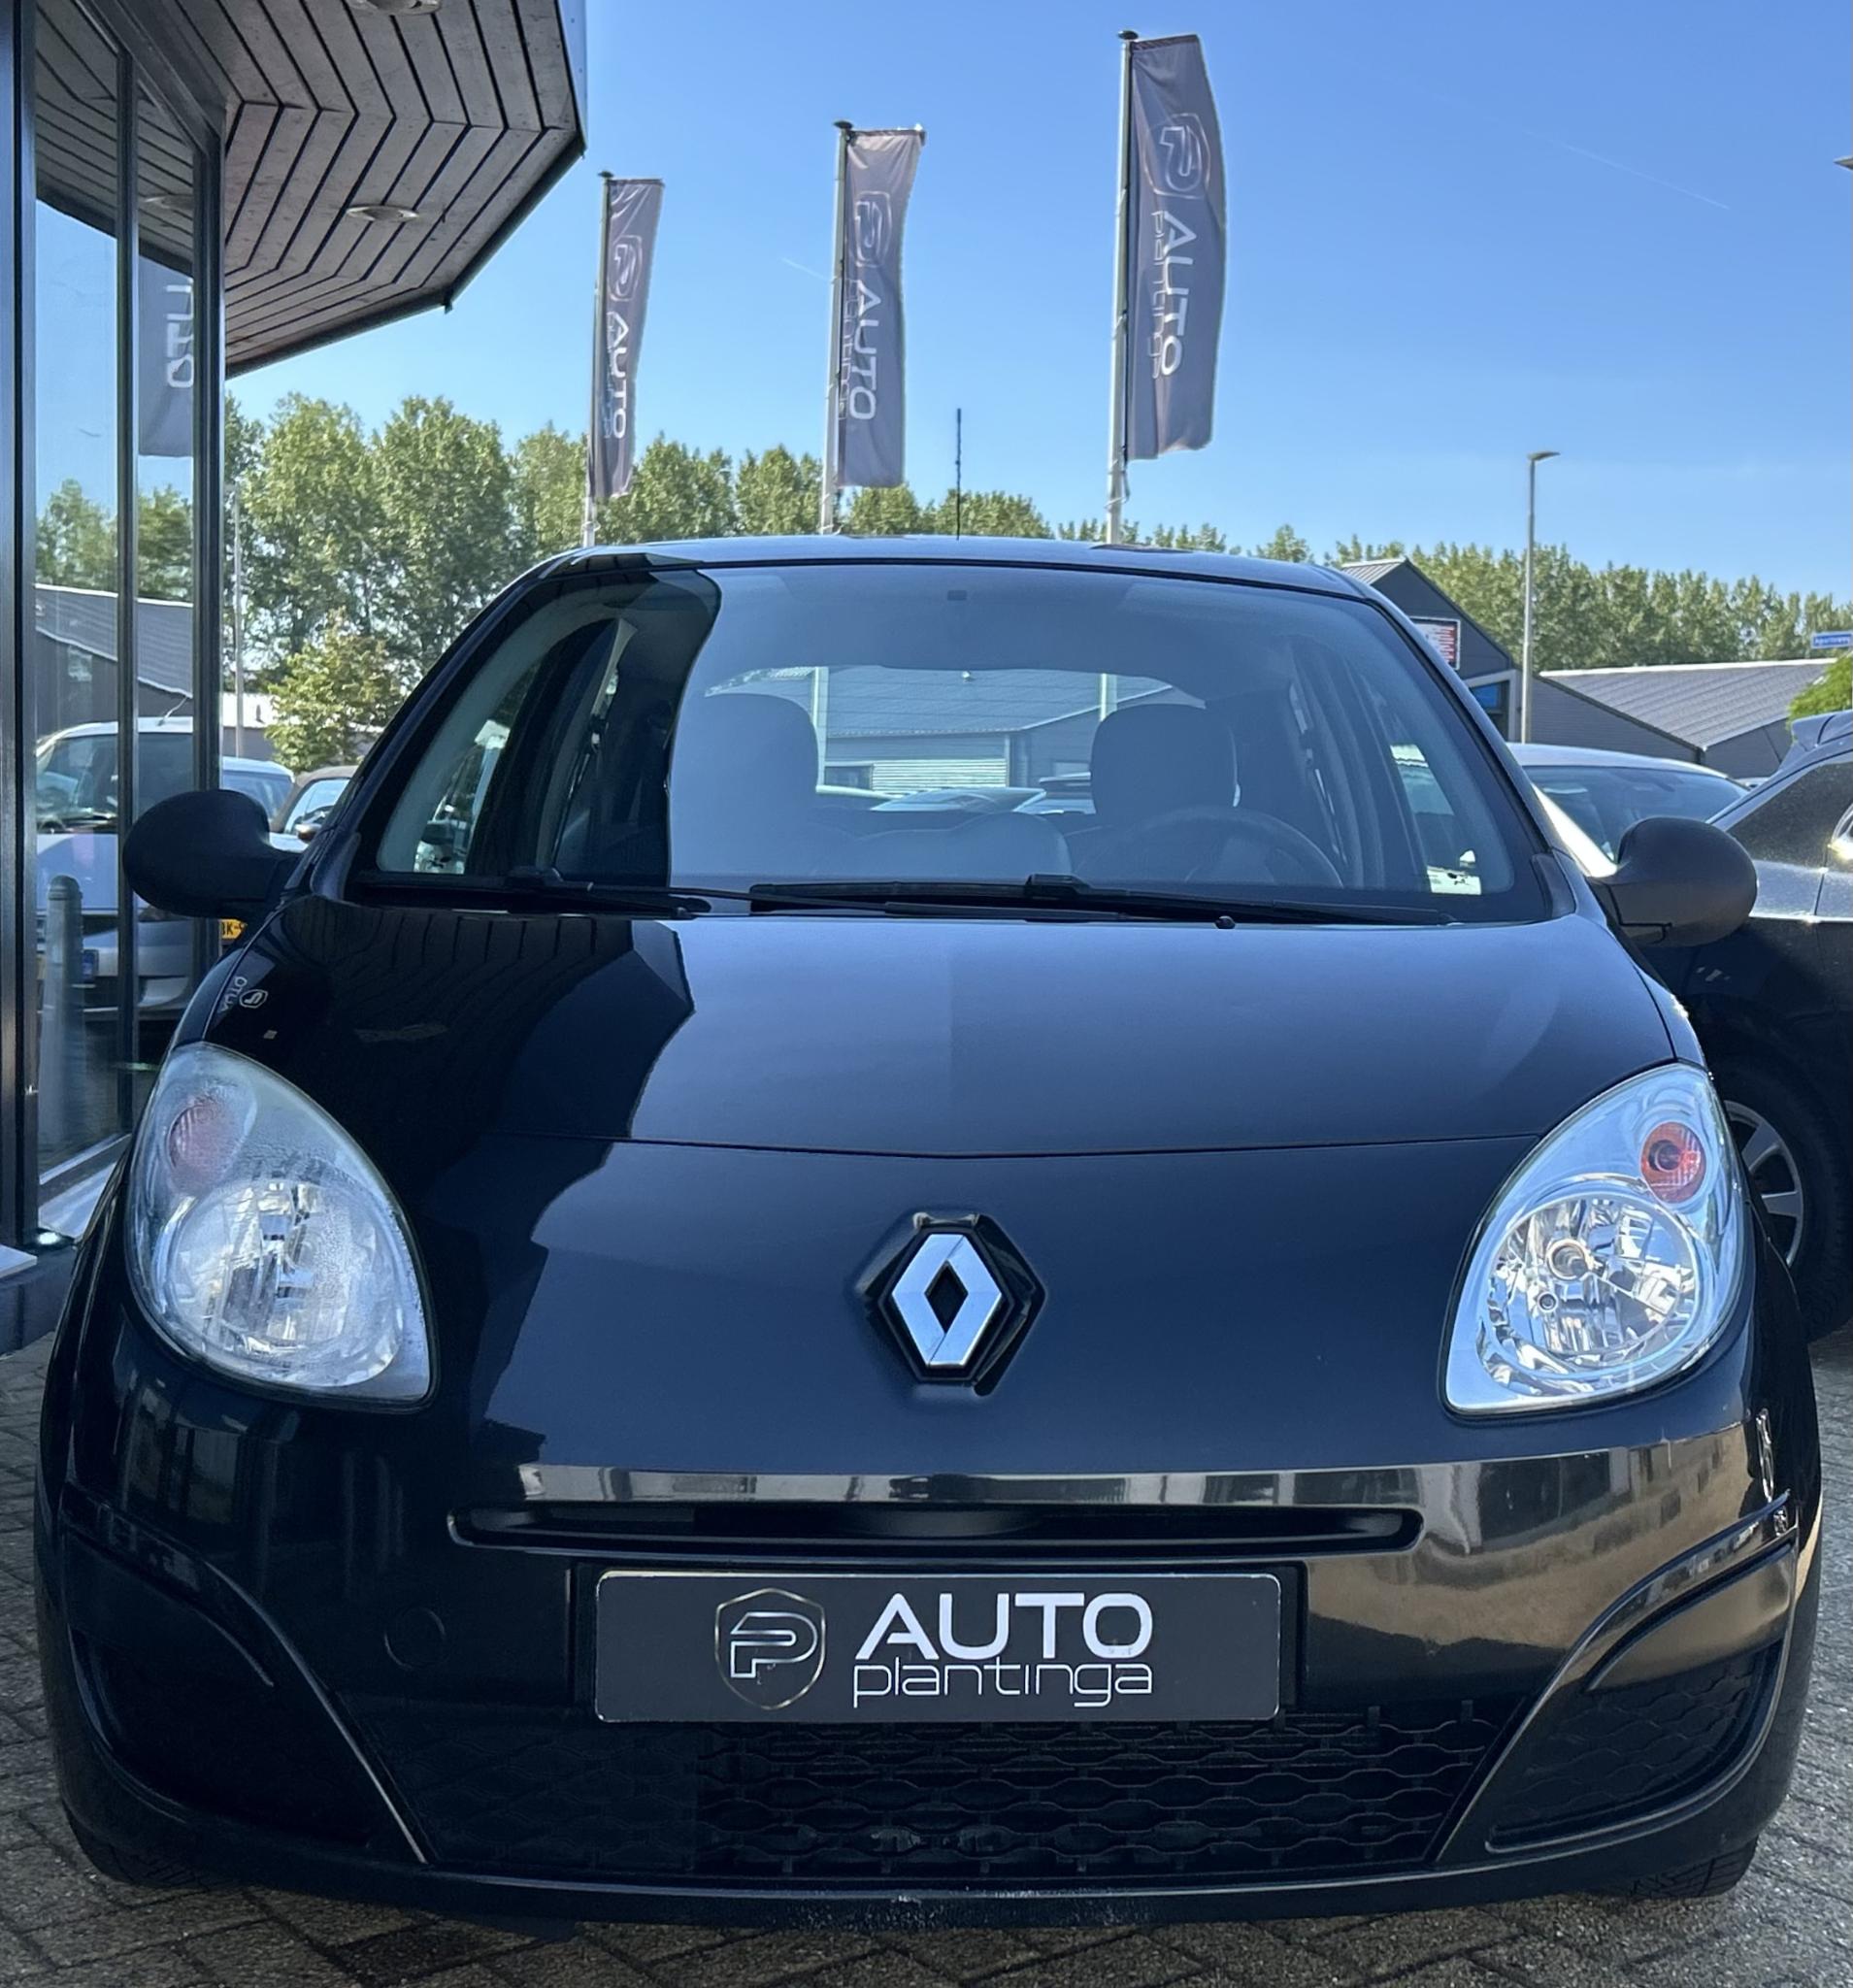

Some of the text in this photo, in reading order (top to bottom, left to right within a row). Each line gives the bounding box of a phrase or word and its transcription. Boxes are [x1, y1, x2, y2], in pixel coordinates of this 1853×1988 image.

[849, 279, 881, 419] AUTO
[1161, 211, 1198, 376] AUTO
[612, 311, 629, 439] AUTO
[853, 1657, 1153, 1707] plantinga
[854, 1592, 1153, 1660] AUTO
